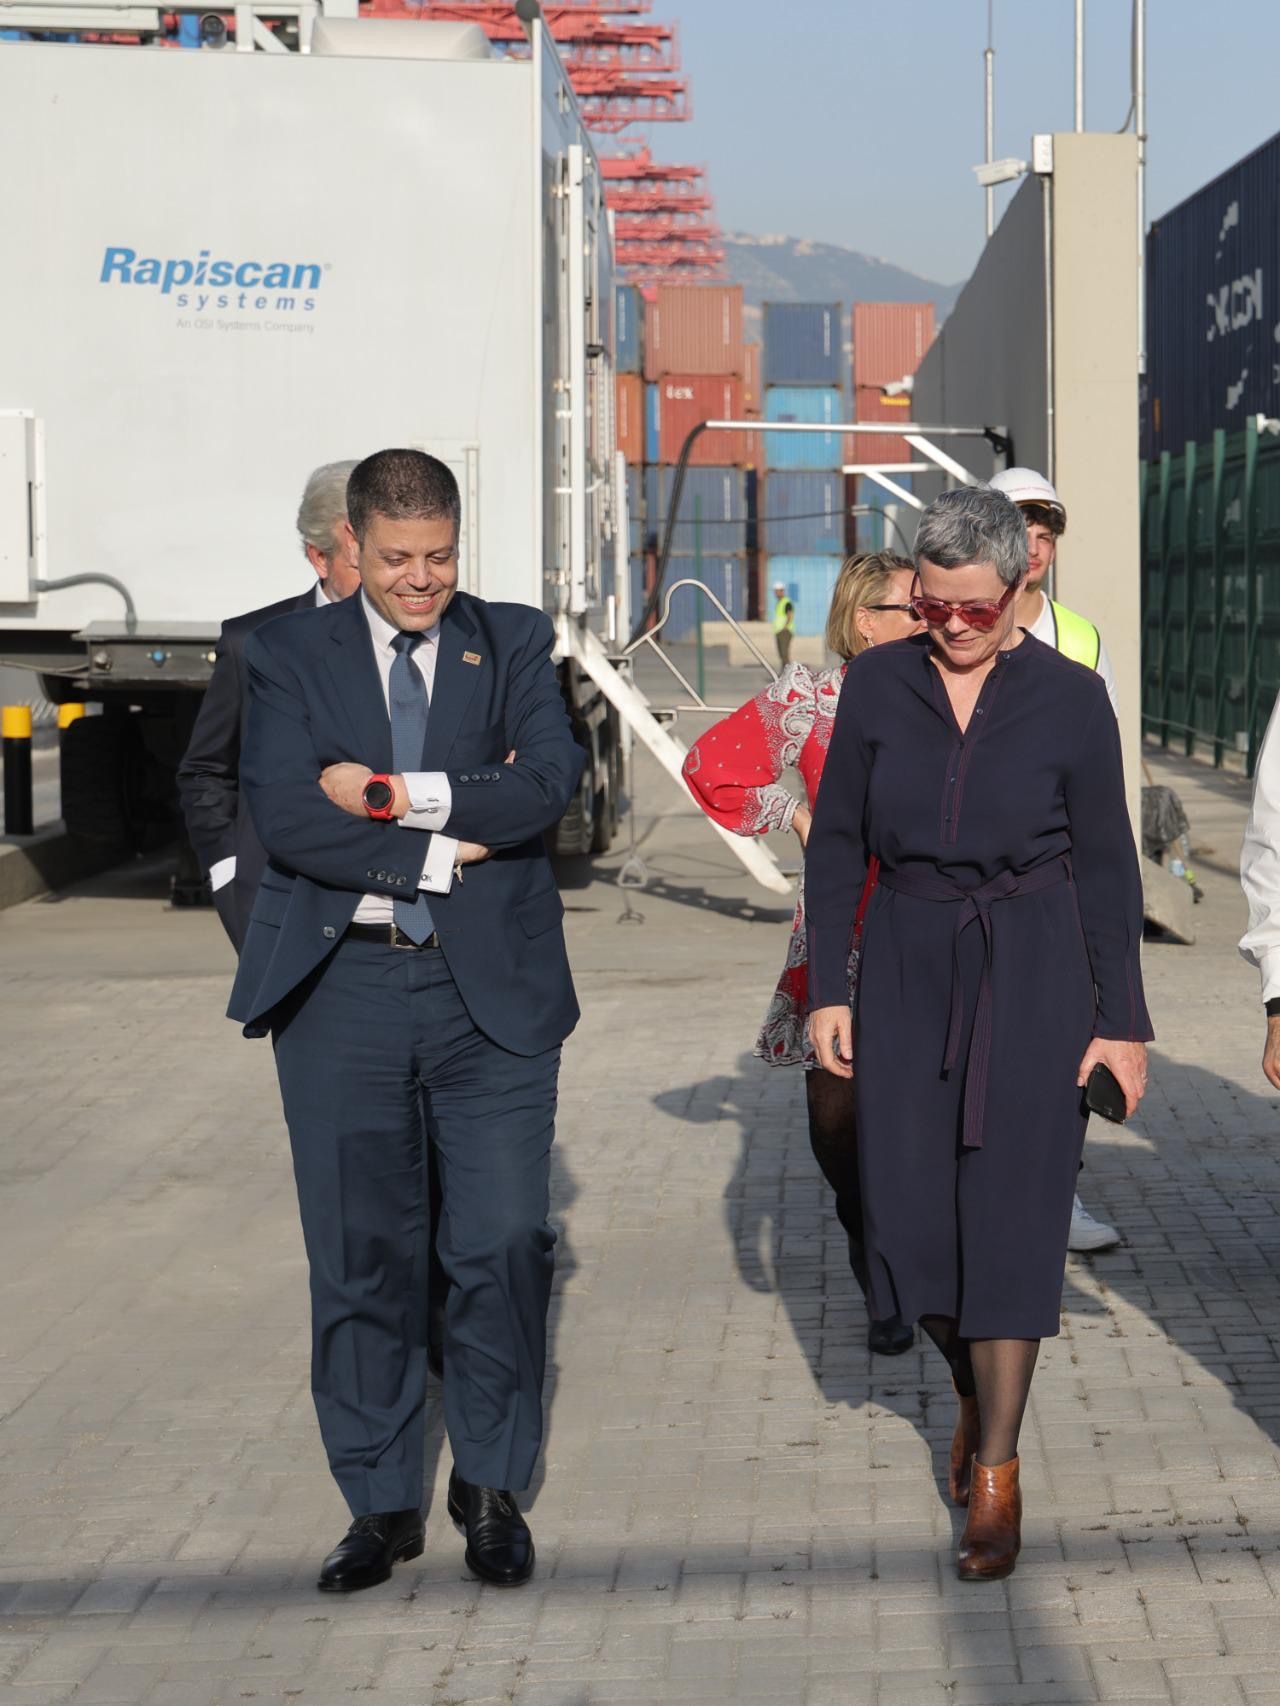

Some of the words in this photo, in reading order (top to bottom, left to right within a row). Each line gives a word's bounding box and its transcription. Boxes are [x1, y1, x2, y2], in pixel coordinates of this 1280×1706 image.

[99, 246, 322, 294] Rapiscan
[176, 293, 316, 311] systems
[176, 318, 191, 329] An
[217, 320, 261, 332] Systems
[264, 321, 315, 334] Company
